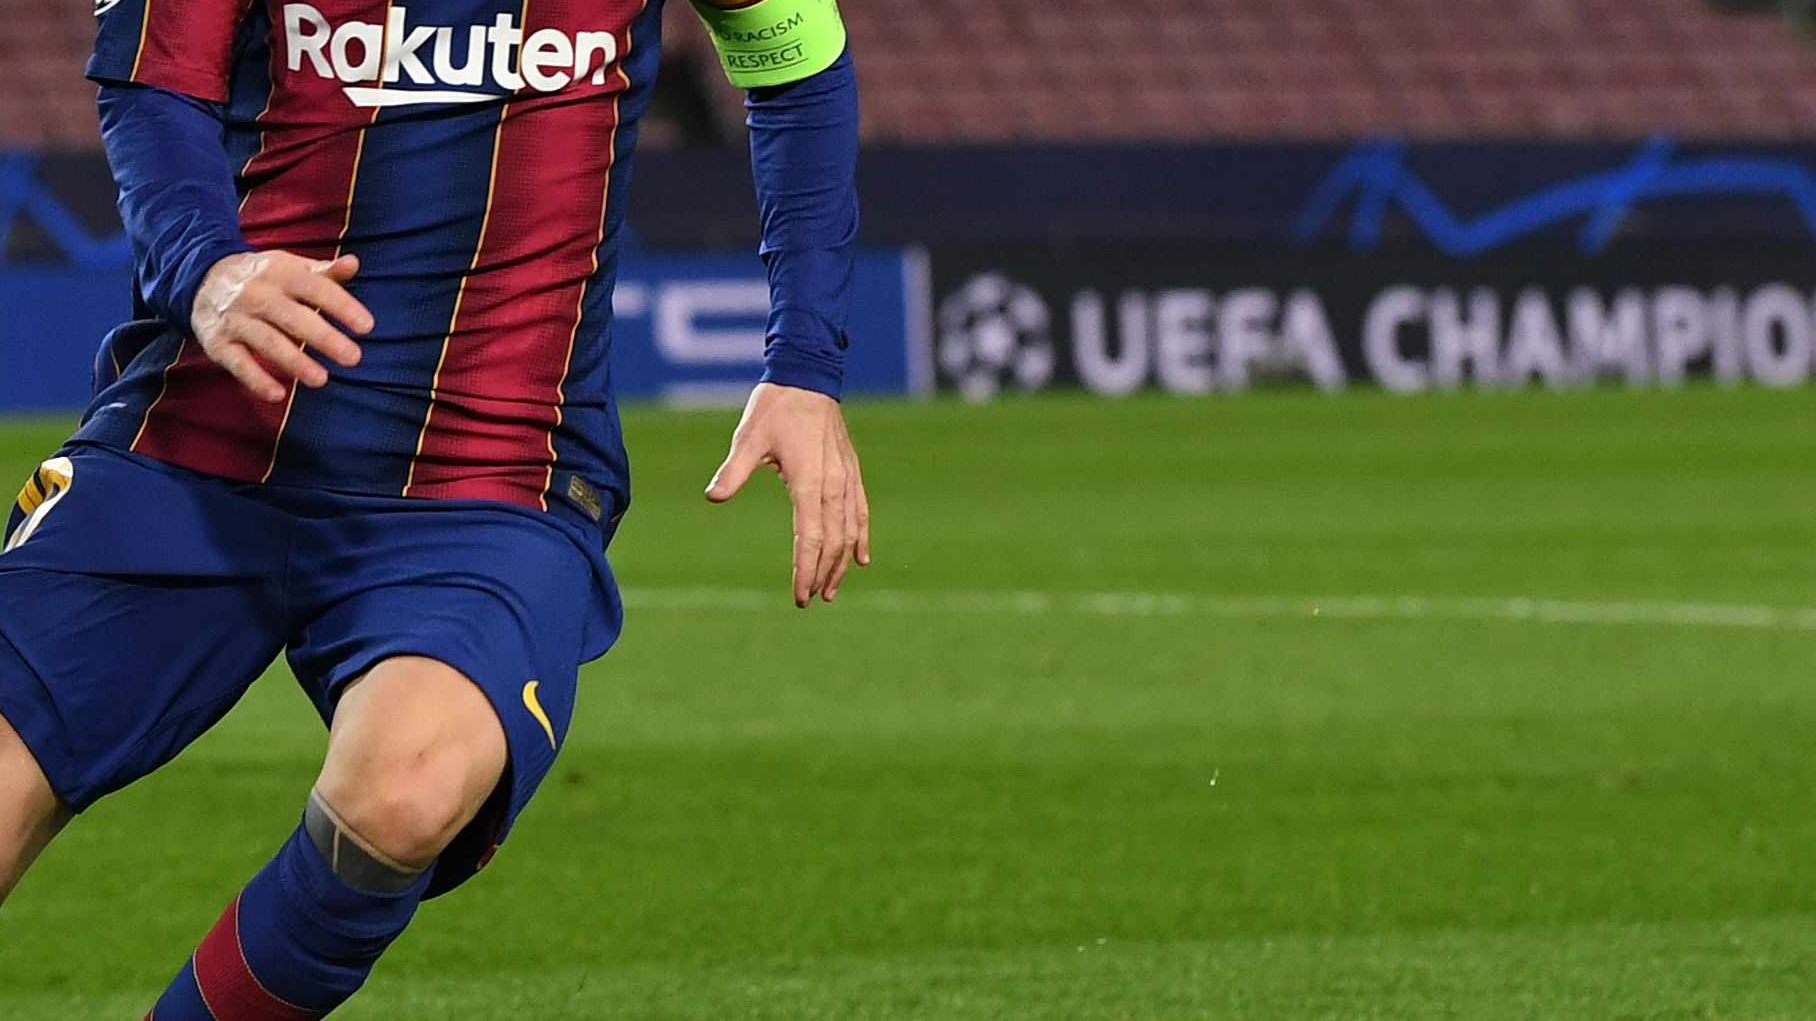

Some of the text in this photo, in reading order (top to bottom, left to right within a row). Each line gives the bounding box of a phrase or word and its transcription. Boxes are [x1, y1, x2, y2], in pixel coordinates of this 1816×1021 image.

[283, 3, 617, 93] Rakuten
[727, 43, 804, 69] RESPECT
[734, 11, 804, 43] RACISM
[1071, 284, 1347, 394] UEFA
